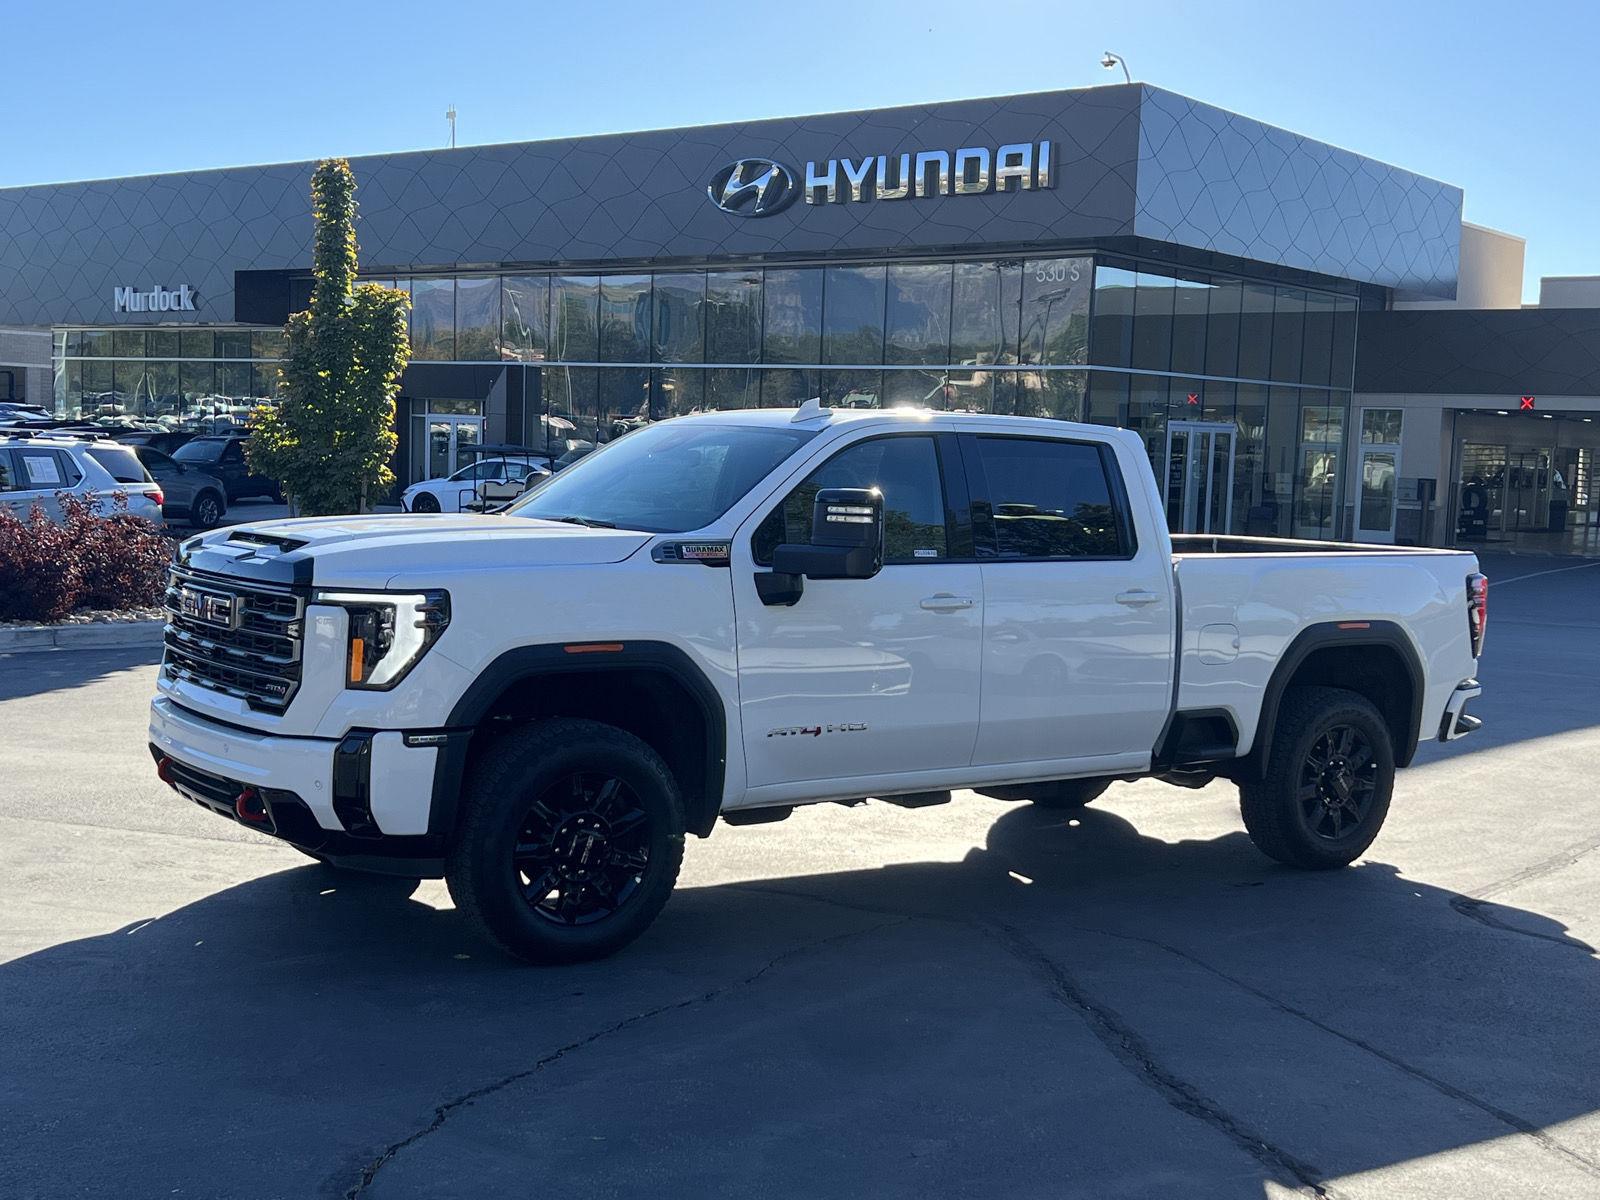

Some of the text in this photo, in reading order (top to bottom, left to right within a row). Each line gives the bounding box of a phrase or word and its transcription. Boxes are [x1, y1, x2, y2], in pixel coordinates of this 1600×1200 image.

[804, 141, 1052, 205] HYUNDAI
[1036, 262, 1080, 282] 530 S
[114, 284, 196, 312] Murdock
[685, 545, 725, 553] DURAMAX
[181, 587, 231, 624] GMC
